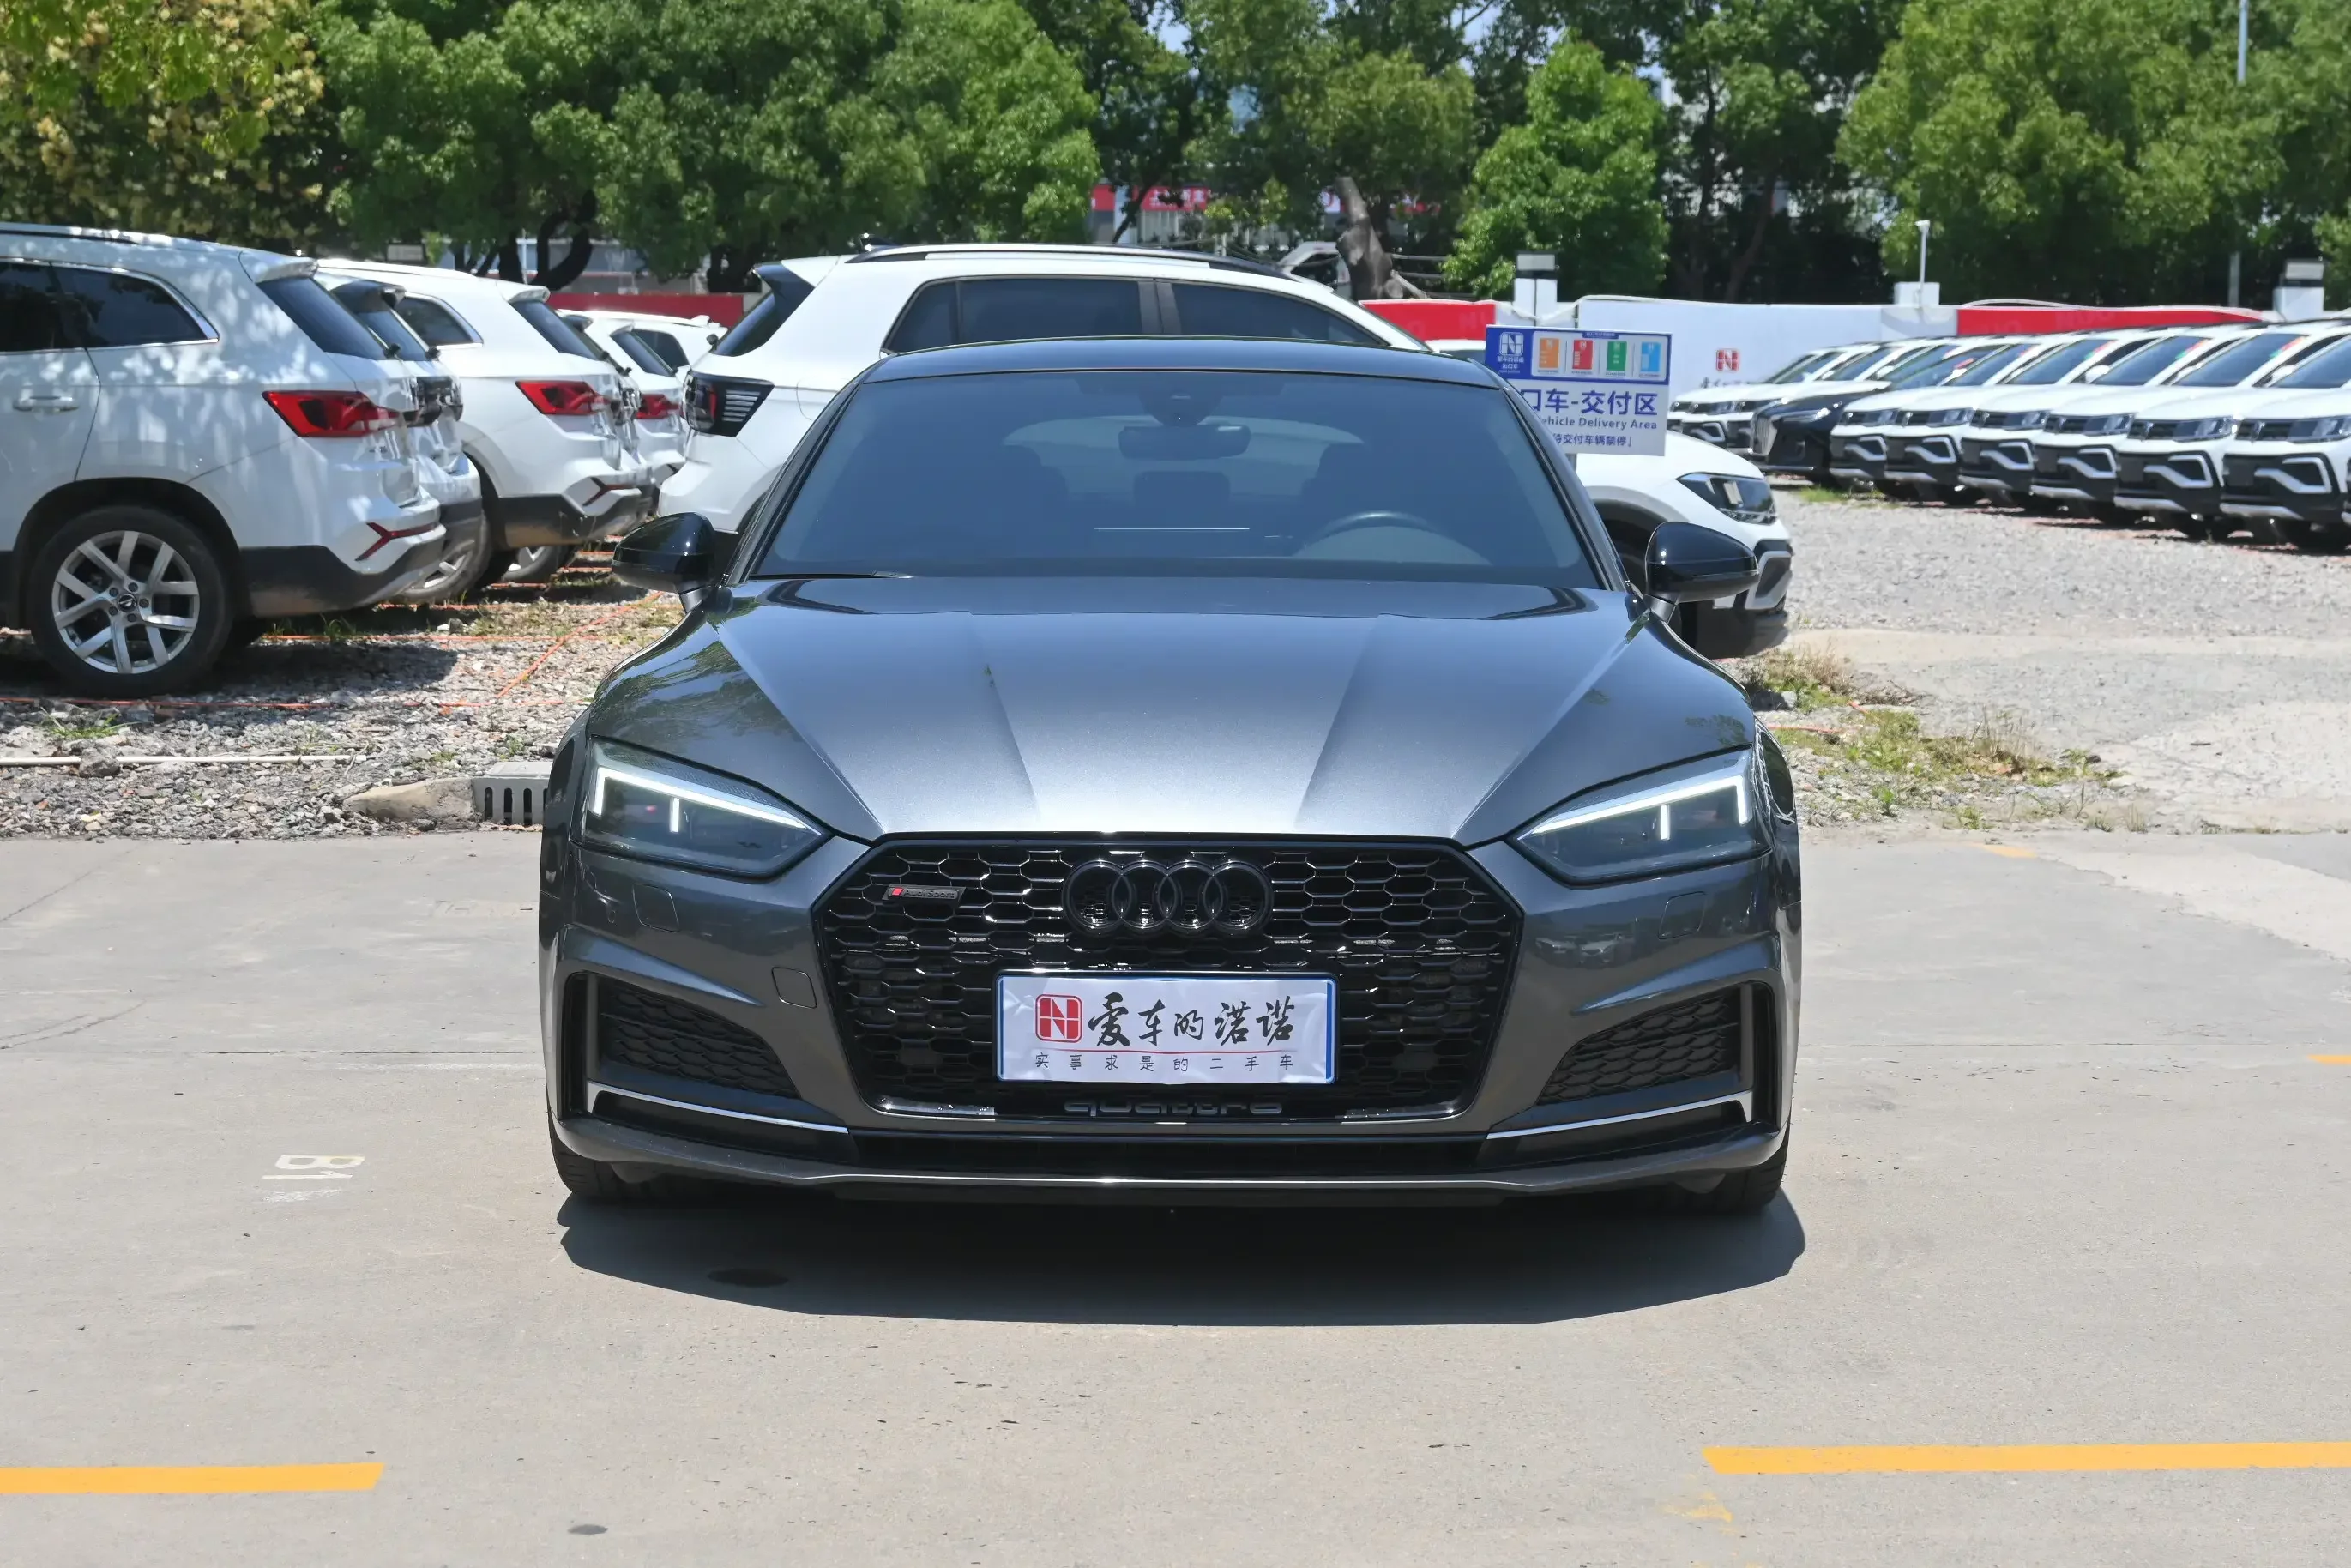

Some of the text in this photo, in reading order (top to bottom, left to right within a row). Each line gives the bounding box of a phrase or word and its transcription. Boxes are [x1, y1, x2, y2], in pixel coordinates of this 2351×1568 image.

[1520, 388, 1658, 416] 口车-交付区
[1541, 416, 1657, 431] ehicle Delivery Area
[927, 890, 955, 899] Sport
[1035, 1052, 1293, 1072] 实事求是的二手车
[1064, 1101, 1283, 1117] quattro
